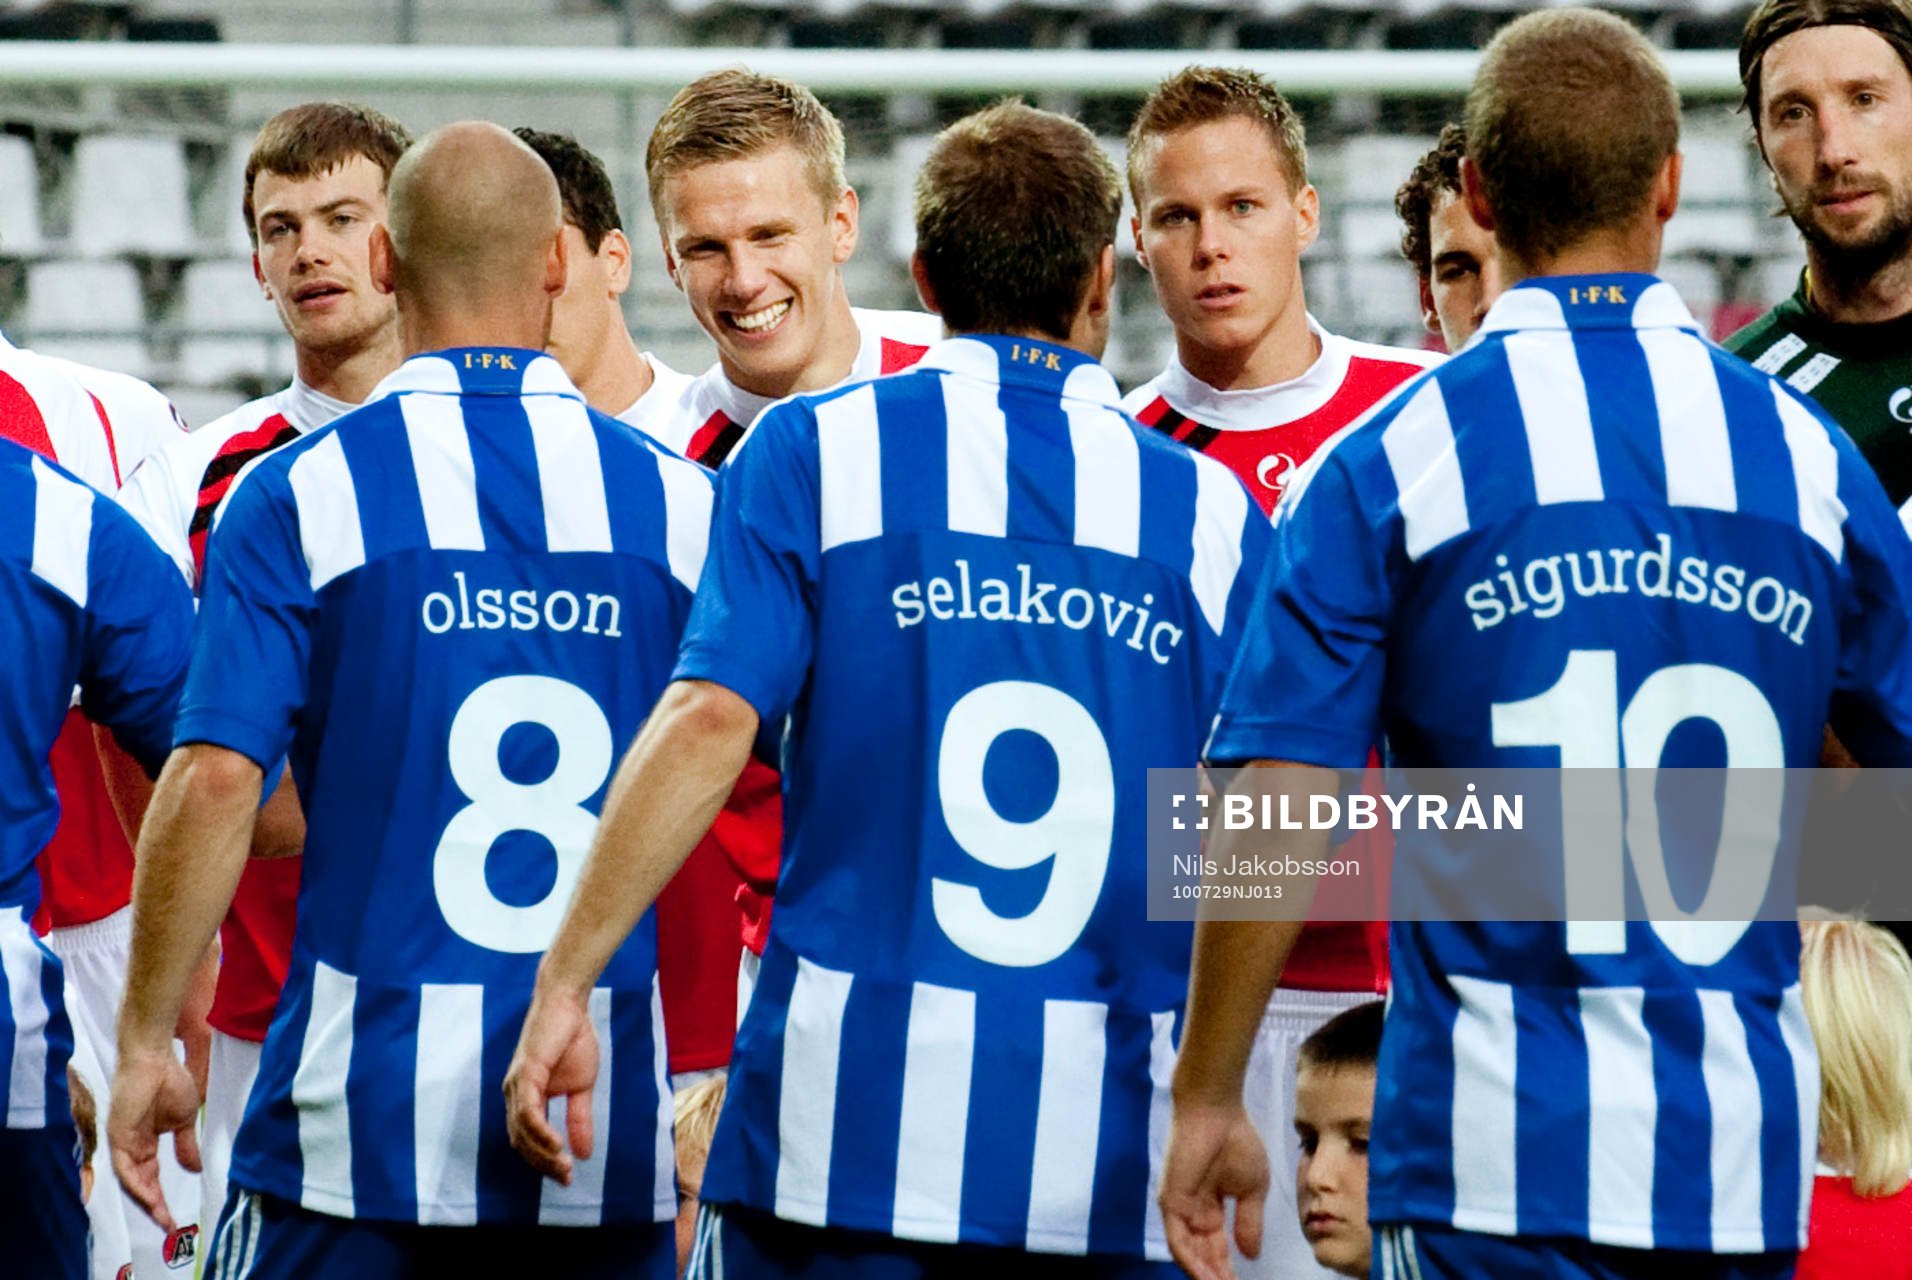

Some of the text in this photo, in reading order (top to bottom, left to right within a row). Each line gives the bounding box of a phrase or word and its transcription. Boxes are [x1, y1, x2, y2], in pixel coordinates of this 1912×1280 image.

[422, 571, 622, 638] olsson
[892, 559, 1183, 665] selakovic
[1464, 533, 1813, 645] sigurdsson
[433, 674, 613, 954] 8
[931, 680, 1115, 968] 9
[1491, 650, 1785, 967] 10
